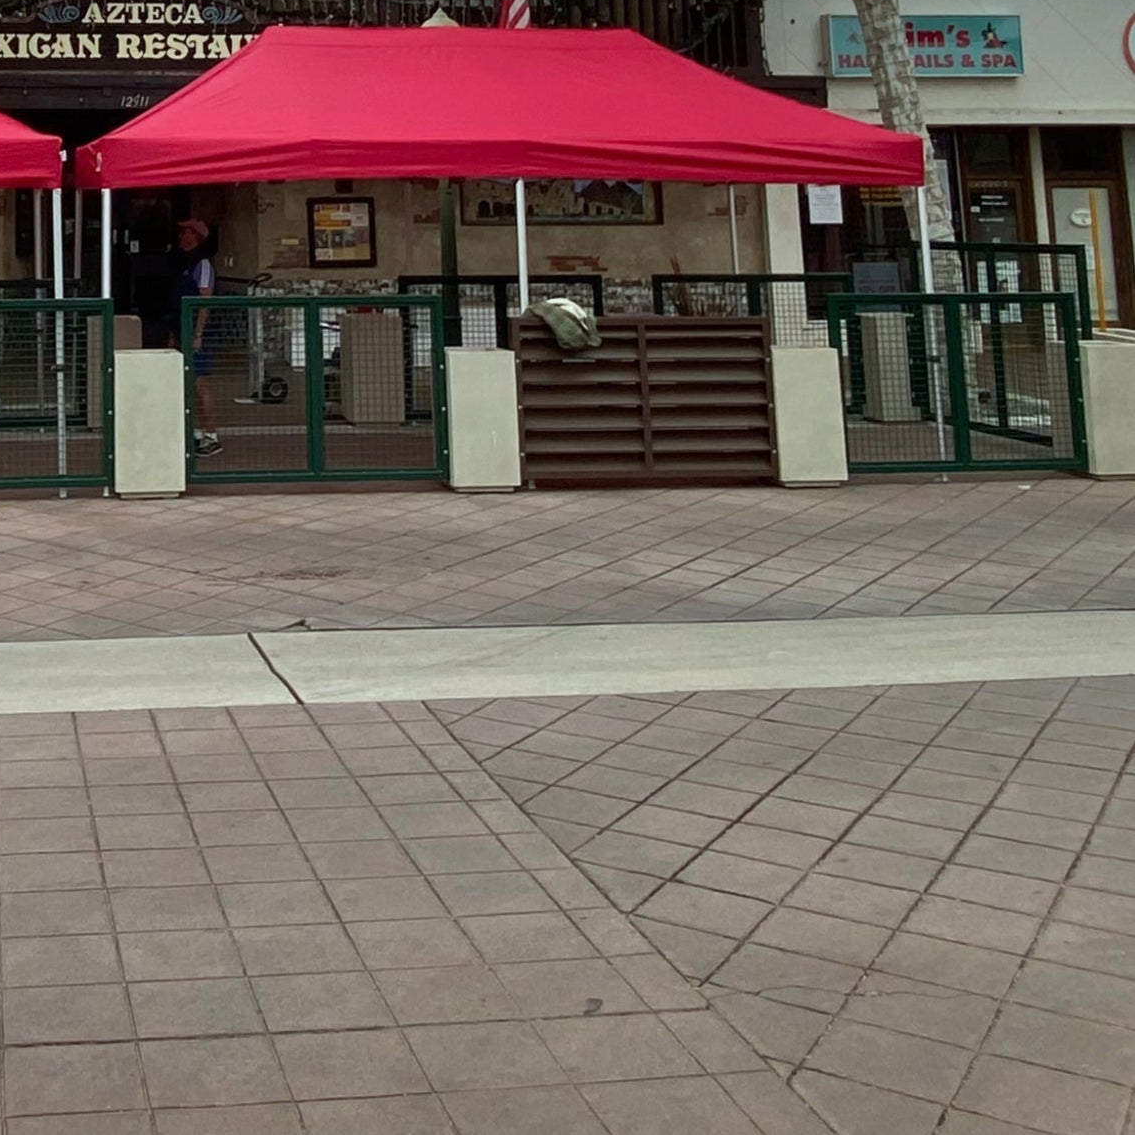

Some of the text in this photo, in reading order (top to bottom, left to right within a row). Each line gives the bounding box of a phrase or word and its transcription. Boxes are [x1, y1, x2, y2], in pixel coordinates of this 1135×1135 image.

[81, 3, 204, 25] AZTECA
[116, 33, 262, 60] RESTAU
[903, 22, 971, 48] im's
[914, 53, 955, 68] AILS
[961, 54, 975, 68] &
[981, 54, 1017, 68] SPA
